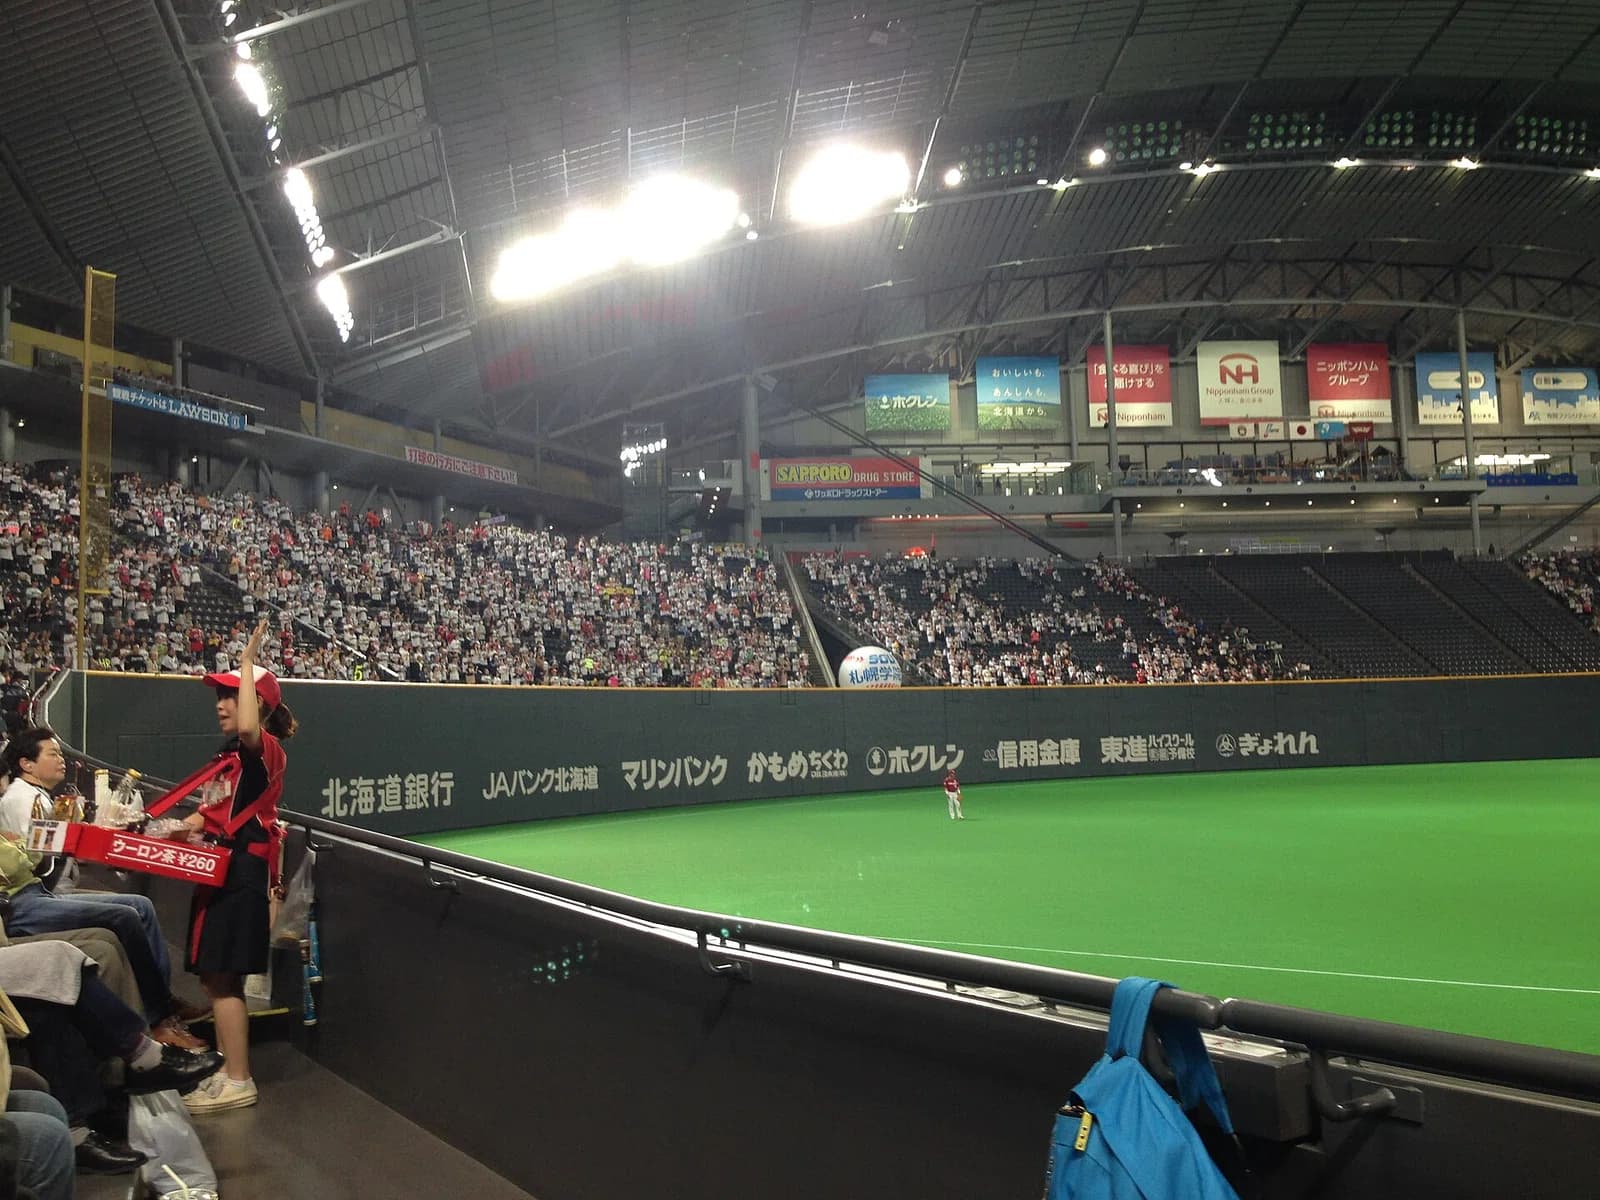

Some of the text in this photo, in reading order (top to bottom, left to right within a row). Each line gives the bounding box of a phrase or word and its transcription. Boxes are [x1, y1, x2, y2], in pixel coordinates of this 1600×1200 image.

[1316, 361, 1379, 372] ニッポンハム
[1206, 387, 1274, 396] Nipponham Group
[1328, 374, 1370, 386] グループ
[168, 399, 229, 426] LAWSON
[893, 396, 938, 409] ホクレン
[1337, 410, 1385, 419] Nipponham
[1118, 413, 1166, 422] Nipponham
[776, 463, 915, 483] SAPPORO DRUG STORE
[998, 738, 1081, 768] 信用金庫
[1100, 733, 1195, 763] 東進 ハイスクール
[1239, 731, 1319, 757] ぎょれん
[888, 744, 964, 774] ホクレン
[482, 765, 599, 800] JAバンク北海道
[622, 754, 728, 791] マリンバンク
[321, 771, 455, 818] 北海道銀行
[112, 839, 216, 873] ウーロン茶 ¥260
